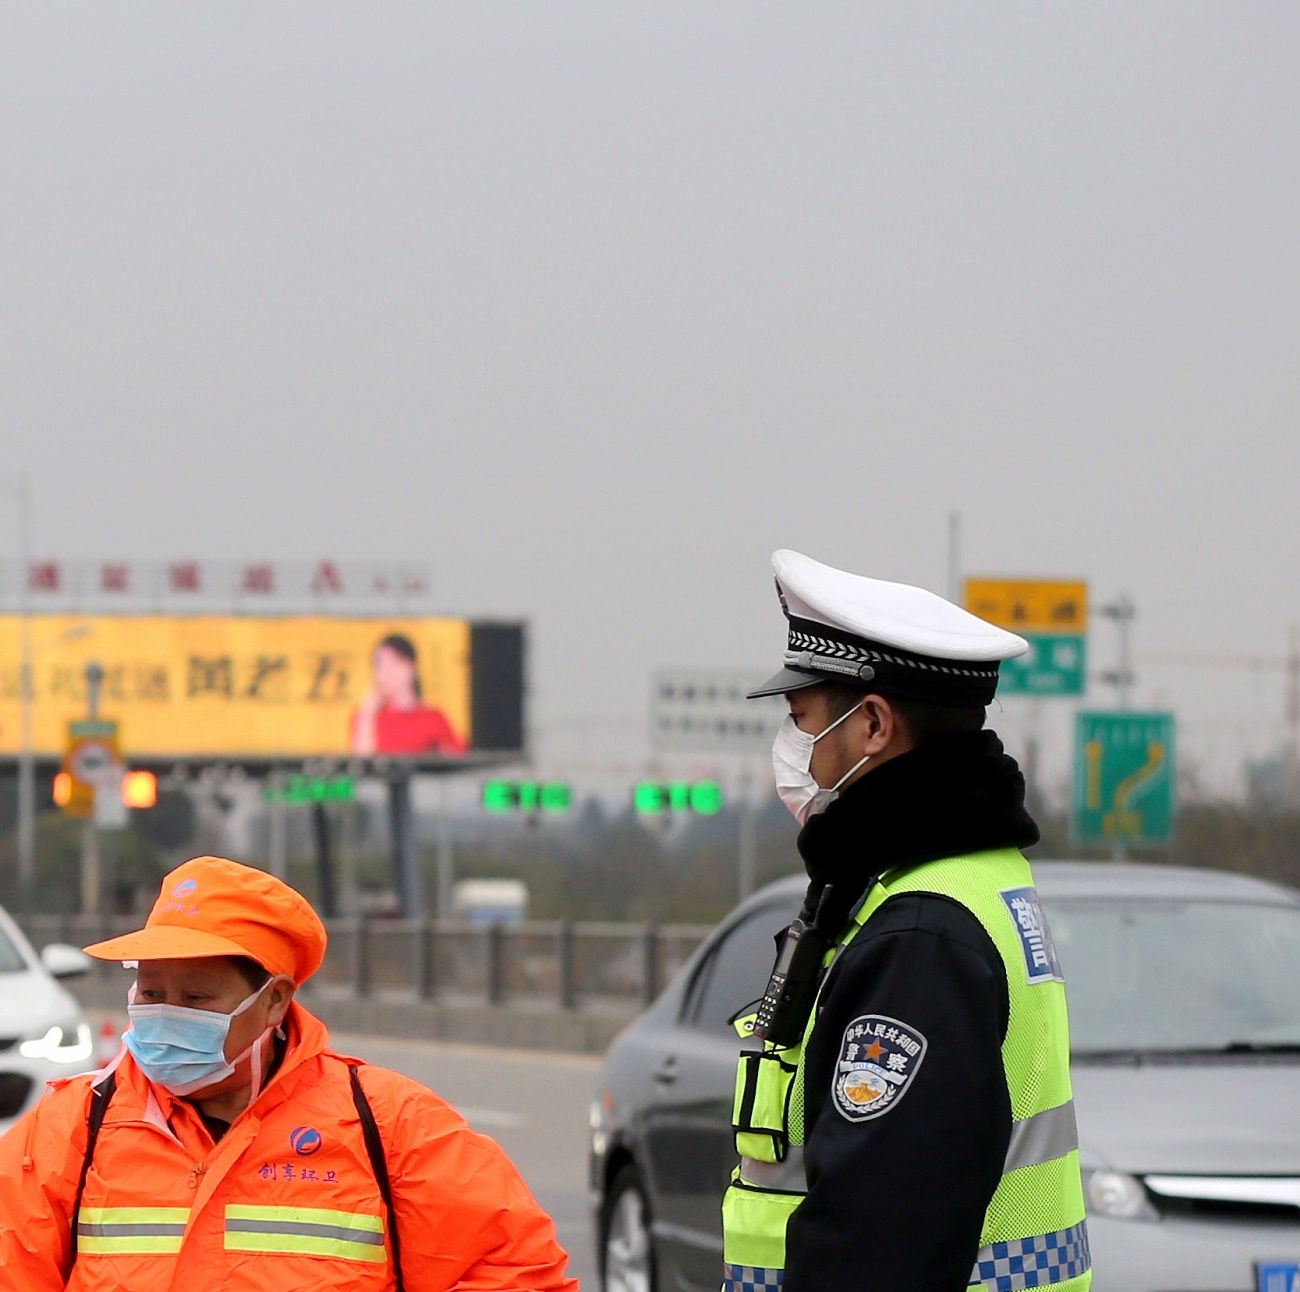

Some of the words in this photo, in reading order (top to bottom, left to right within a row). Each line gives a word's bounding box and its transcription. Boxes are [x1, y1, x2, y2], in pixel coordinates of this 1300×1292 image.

[847, 1023, 921, 1057] 中华人民共和国
[853, 1062, 887, 1076] POLICE
[258, 1163, 339, 1183] 创享环卫
